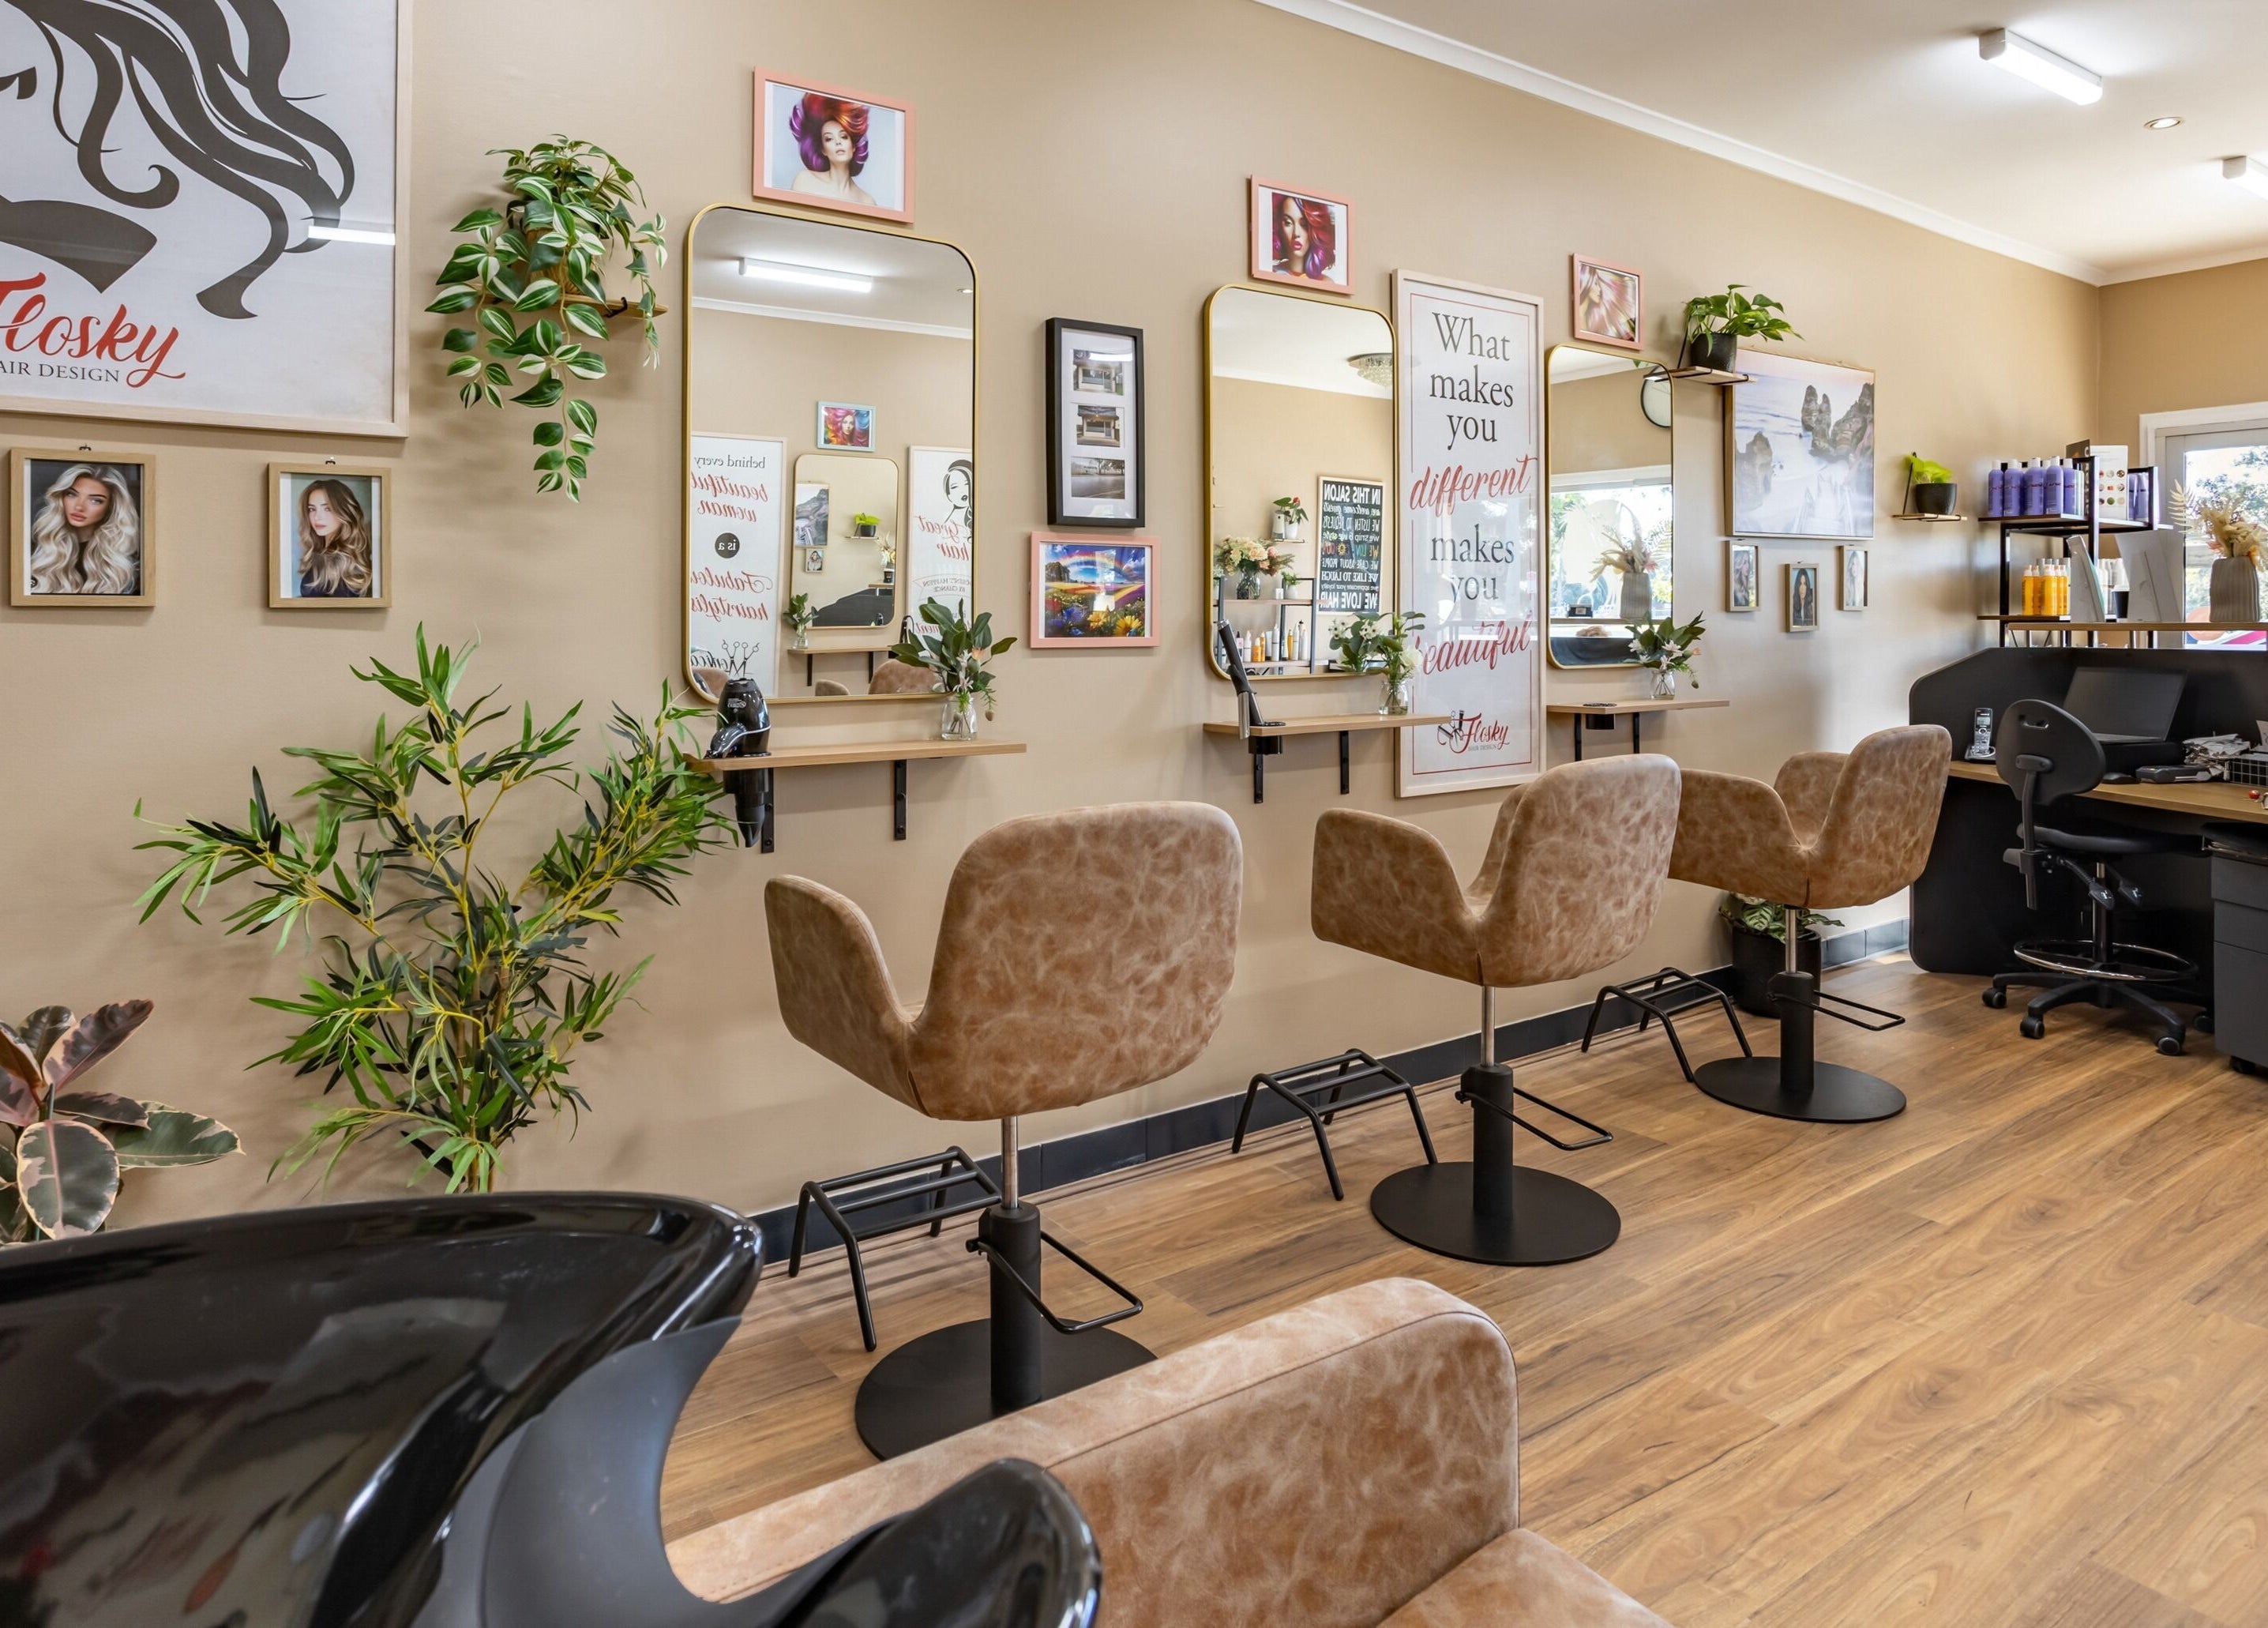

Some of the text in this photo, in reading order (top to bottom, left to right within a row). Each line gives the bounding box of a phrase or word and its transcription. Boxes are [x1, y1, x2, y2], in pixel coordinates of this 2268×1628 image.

[1432, 312, 1510, 361] What
[39, 363, 120, 382] DESIGN
[1429, 364, 1514, 408] makes
[1447, 415, 1497, 450] you
[1410, 454, 1538, 517] different
[1430, 524, 1515, 563] makes
[1451, 577, 1499, 603] you
[1415, 610, 1532, 675] eautiful
[1448, 712, 1510, 753] Flosky
